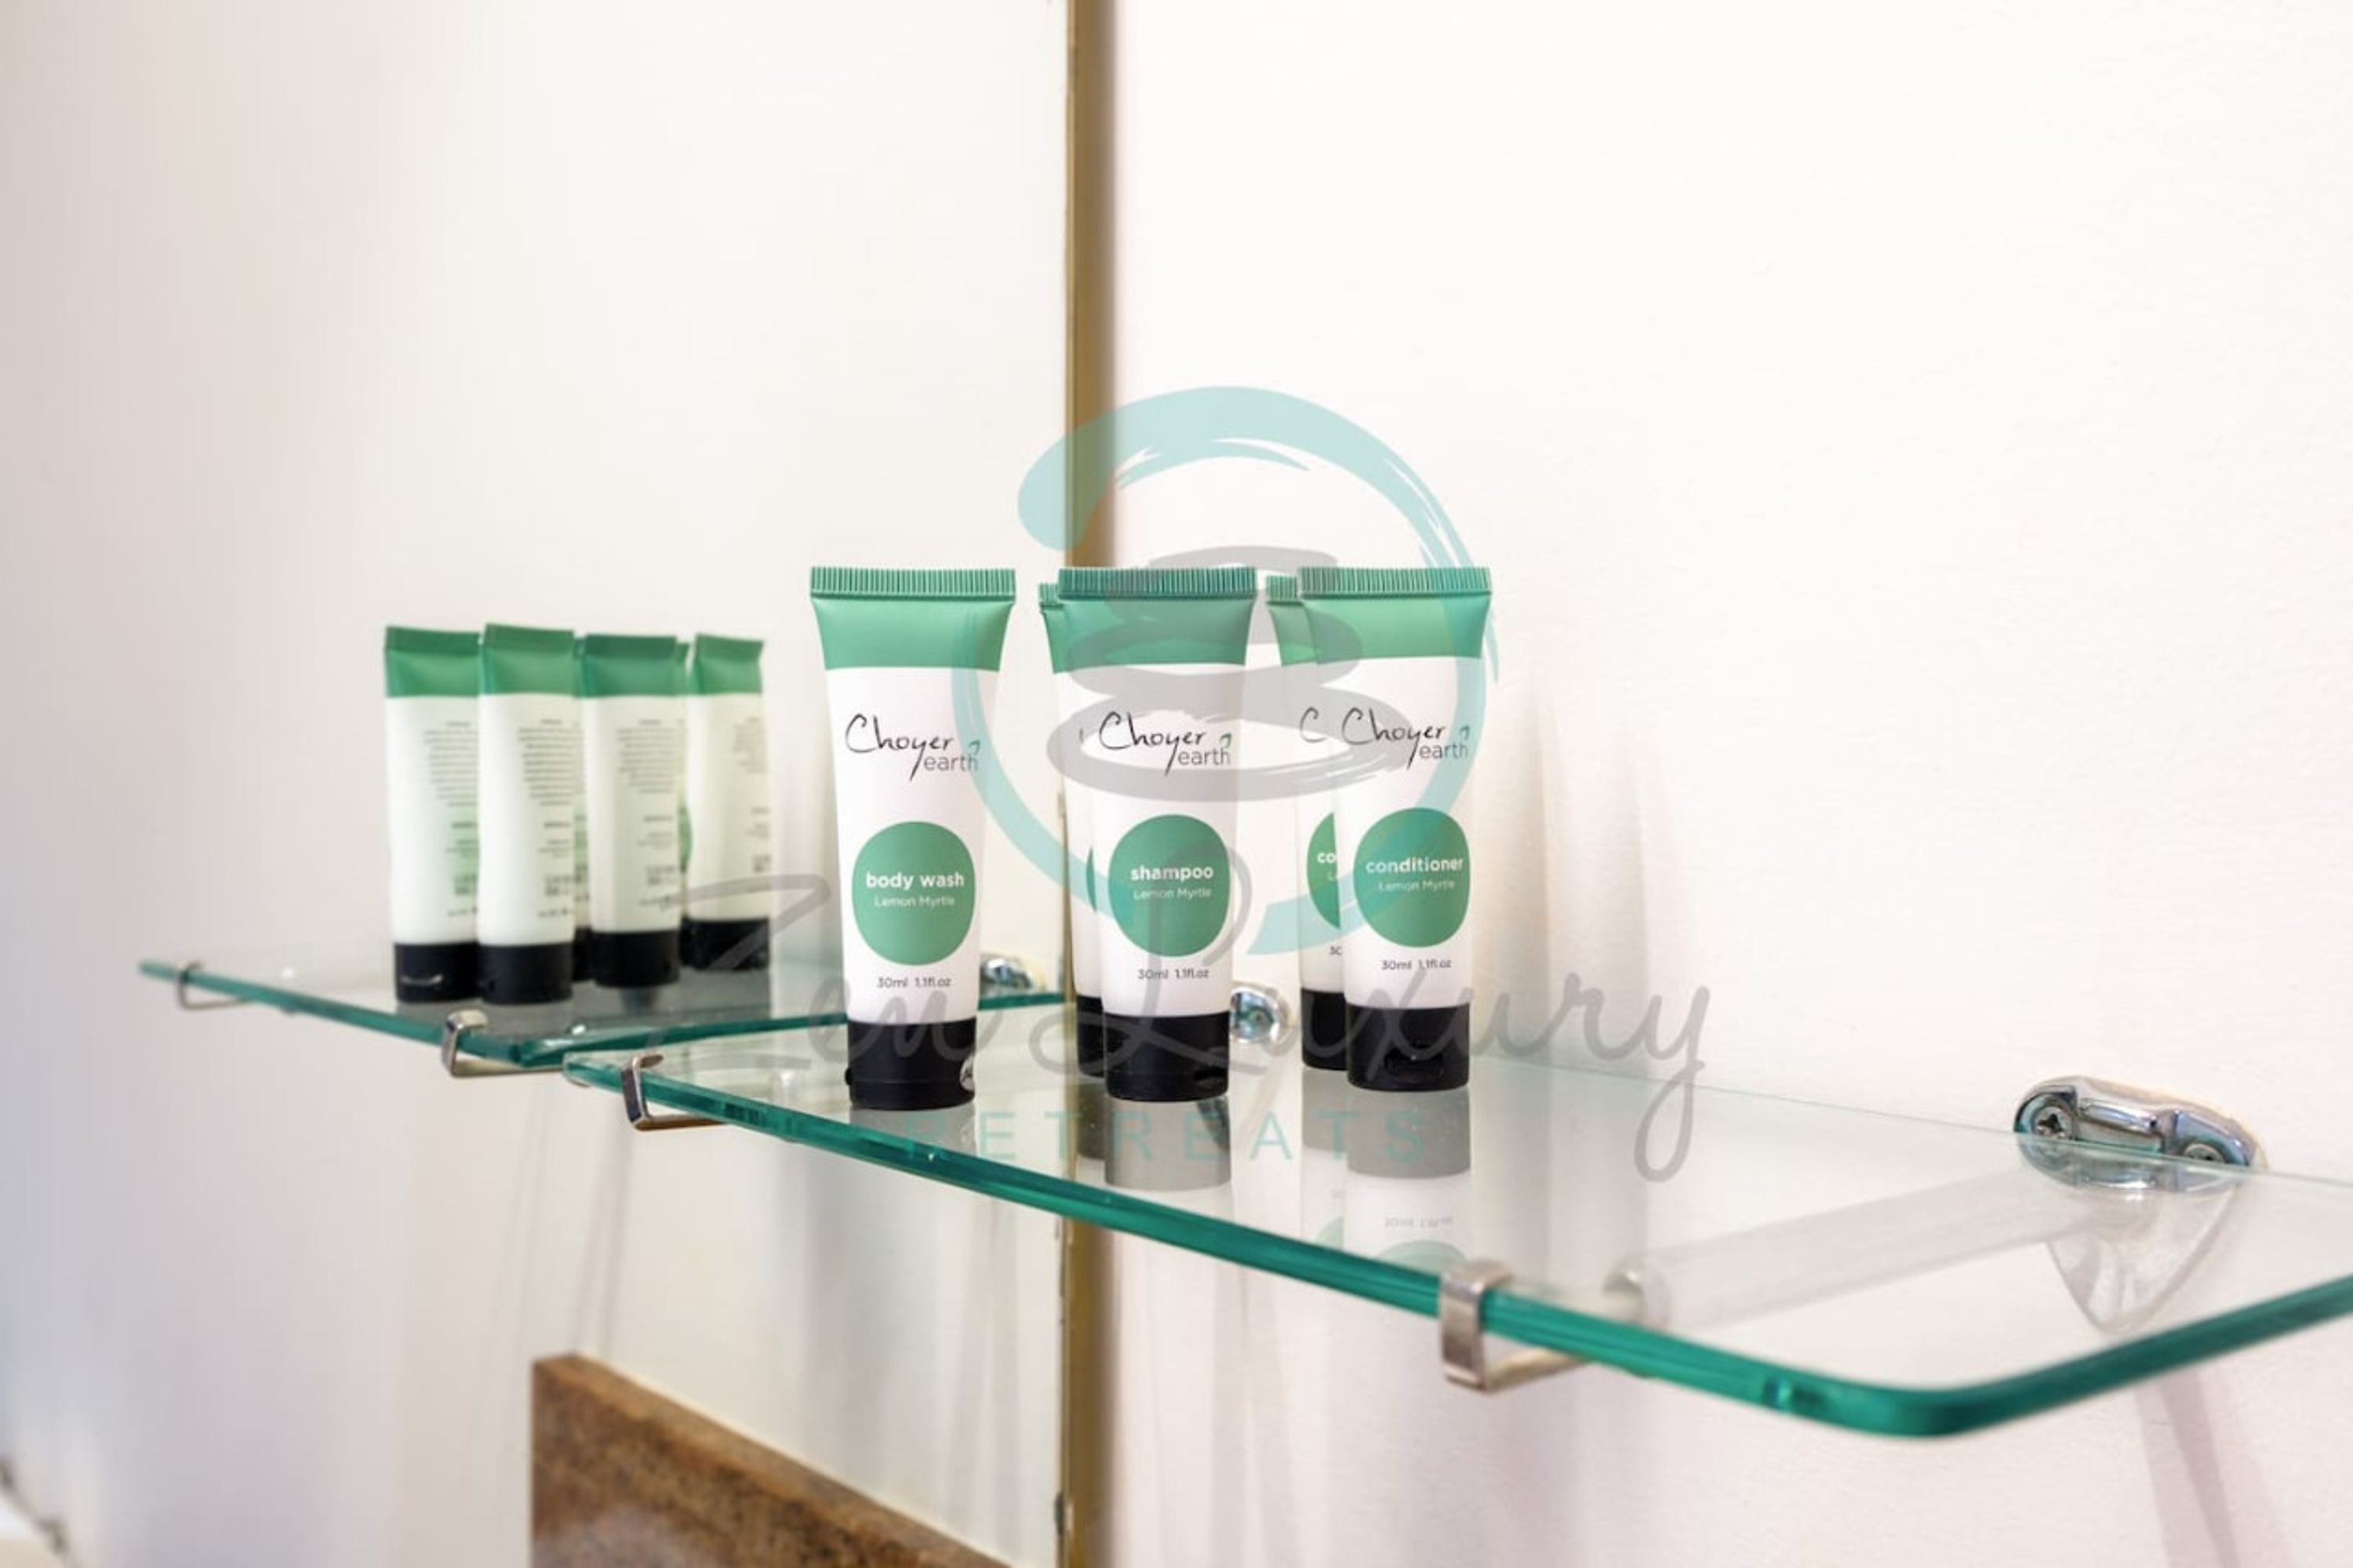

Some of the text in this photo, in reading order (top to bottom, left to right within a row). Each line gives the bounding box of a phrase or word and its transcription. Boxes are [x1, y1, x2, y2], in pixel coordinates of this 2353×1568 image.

[845, 713, 954, 781] Choyer
[1098, 711, 1208, 777] Choyer
[1341, 707, 1446, 770] Choyer
[1177, 747, 1231, 766] earth
[1419, 742, 1470, 760] earth
[923, 753, 980, 772] earth
[1130, 865, 1214, 882] shampoo
[1366, 857, 1464, 873] conditioner
[866, 871, 965, 890] body wash
[1378, 879, 1455, 892] Lemon Myrtle
[874, 895, 955, 908] Lemon Myrtle
[1133, 887, 1212, 900] Lemon Myrtle
[1381, 959, 1413, 970] 30ml
[877, 977, 908, 988] 30ml
[1137, 968, 1169, 980] 30ml
